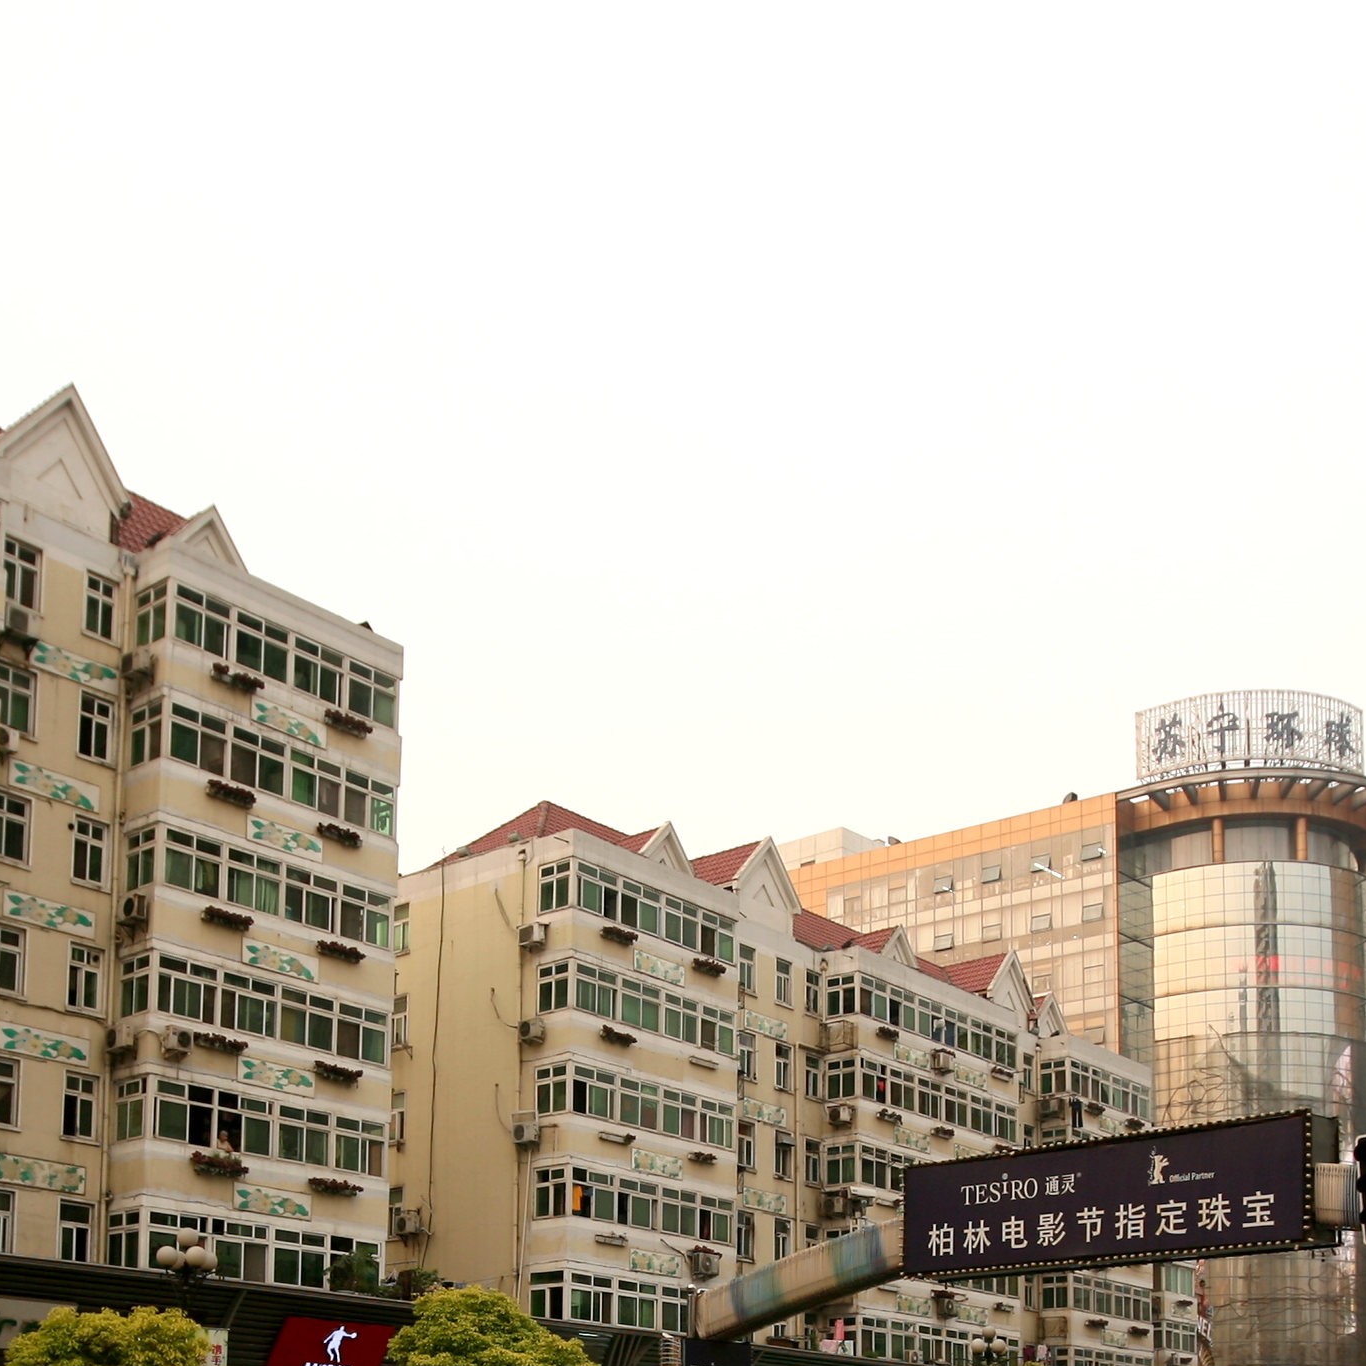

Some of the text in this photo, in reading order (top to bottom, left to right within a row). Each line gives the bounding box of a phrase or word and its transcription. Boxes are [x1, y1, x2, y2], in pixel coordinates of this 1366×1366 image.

[1044, 1173, 1076, 1198] 通灵
[1169, 1170, 1215, 1183] Official Partner
[927, 1190, 1276, 1258] 柏林电影节指定珠宝
